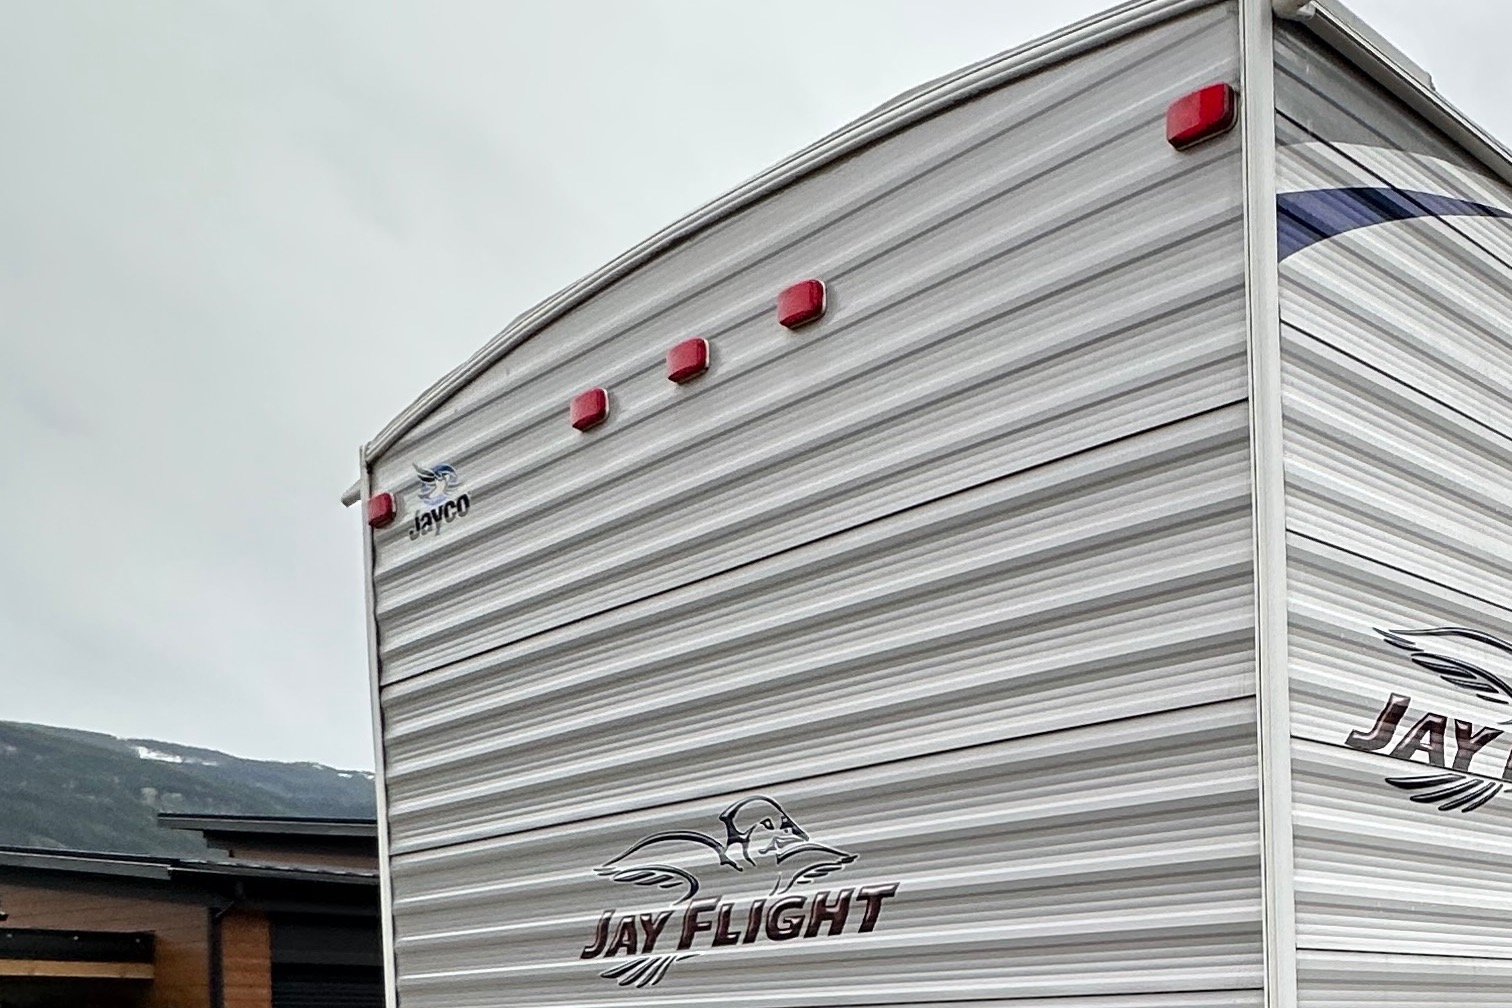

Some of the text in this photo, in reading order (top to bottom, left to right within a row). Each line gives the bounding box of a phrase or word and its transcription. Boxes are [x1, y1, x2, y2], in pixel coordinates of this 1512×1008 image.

[1344, 692, 1504, 774] JAY
[579, 881, 900, 960] JAY FLIGHT
